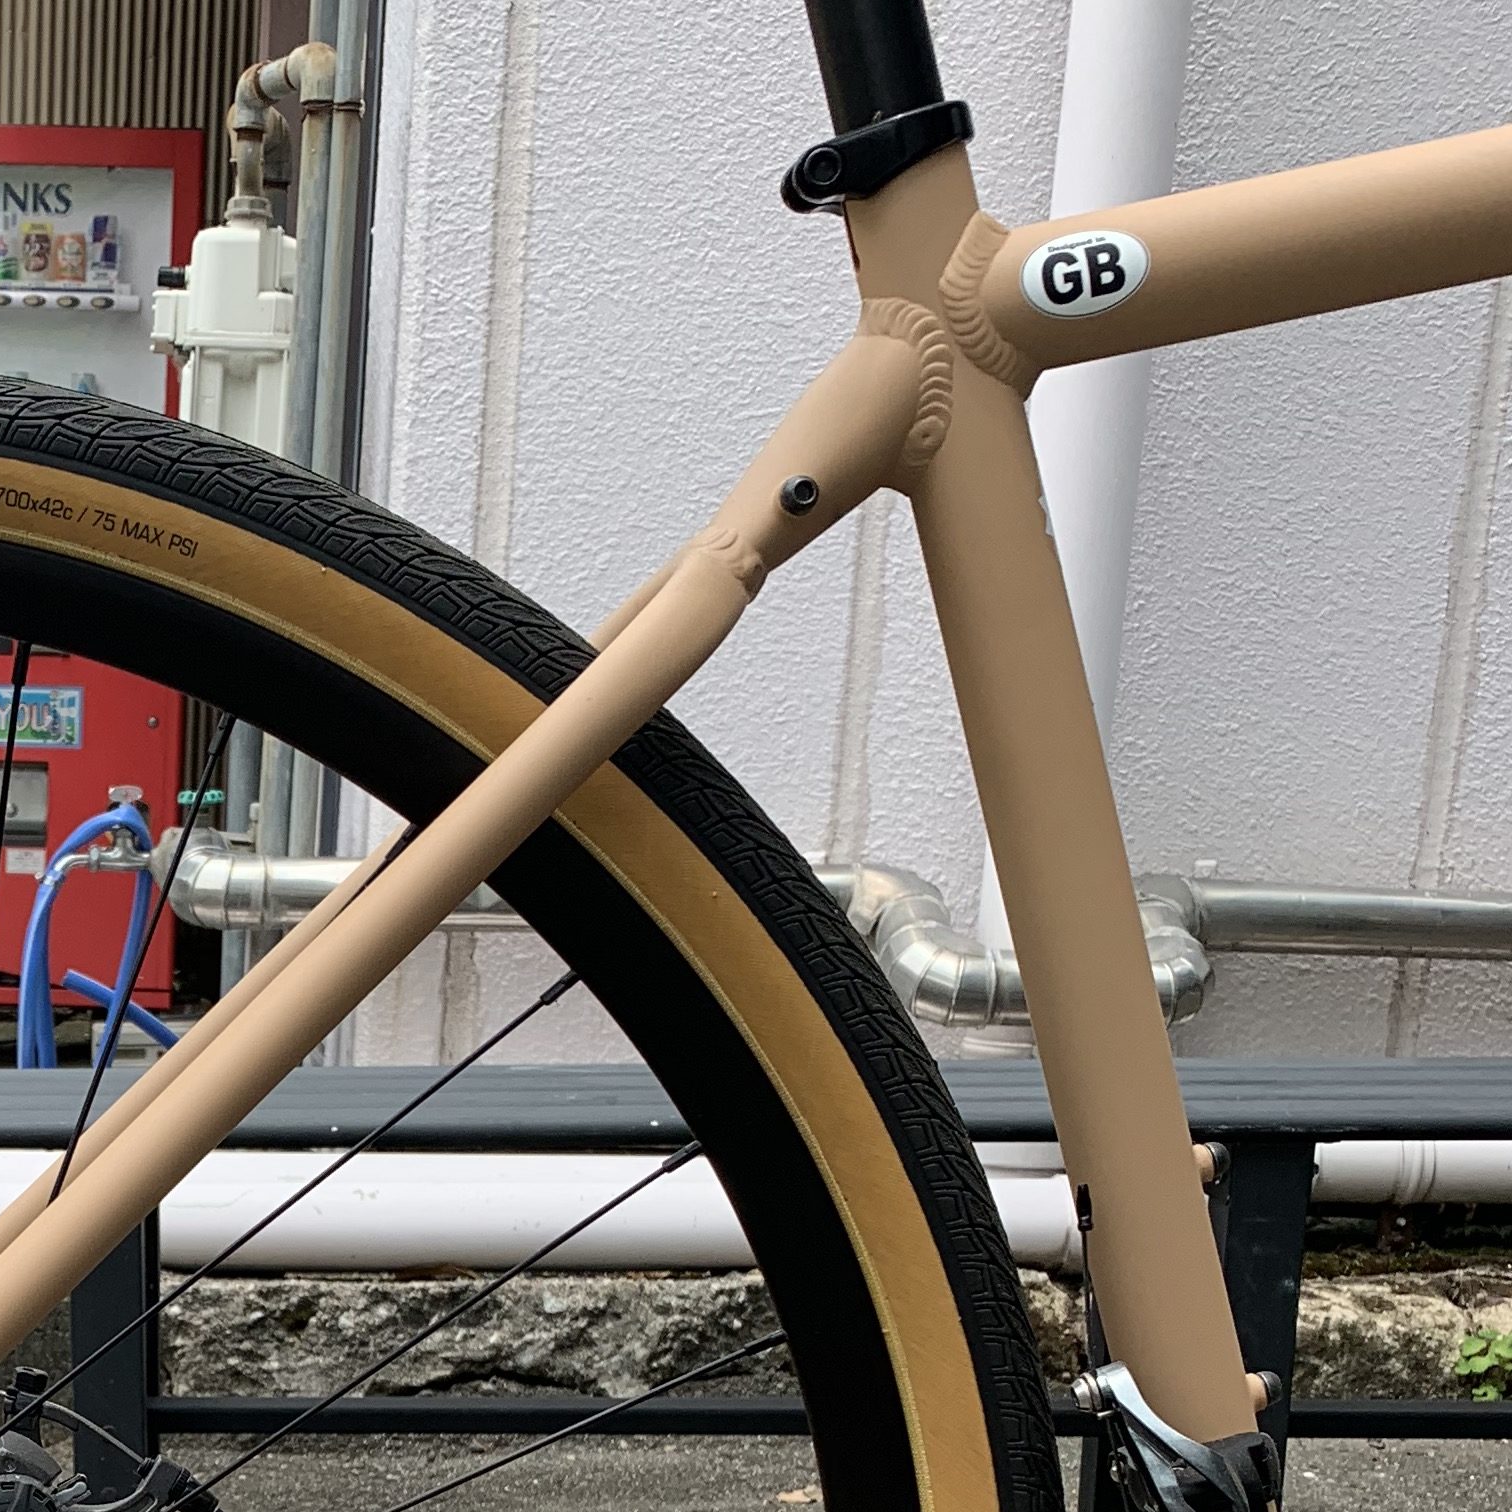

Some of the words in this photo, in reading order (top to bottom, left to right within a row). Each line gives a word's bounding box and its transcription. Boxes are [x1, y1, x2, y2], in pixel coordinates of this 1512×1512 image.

[1042, 243, 1126, 305] GB
[92, 508, 116, 532] 75
[120, 518, 165, 549] MAX
[169, 533, 199, 559] PSI
